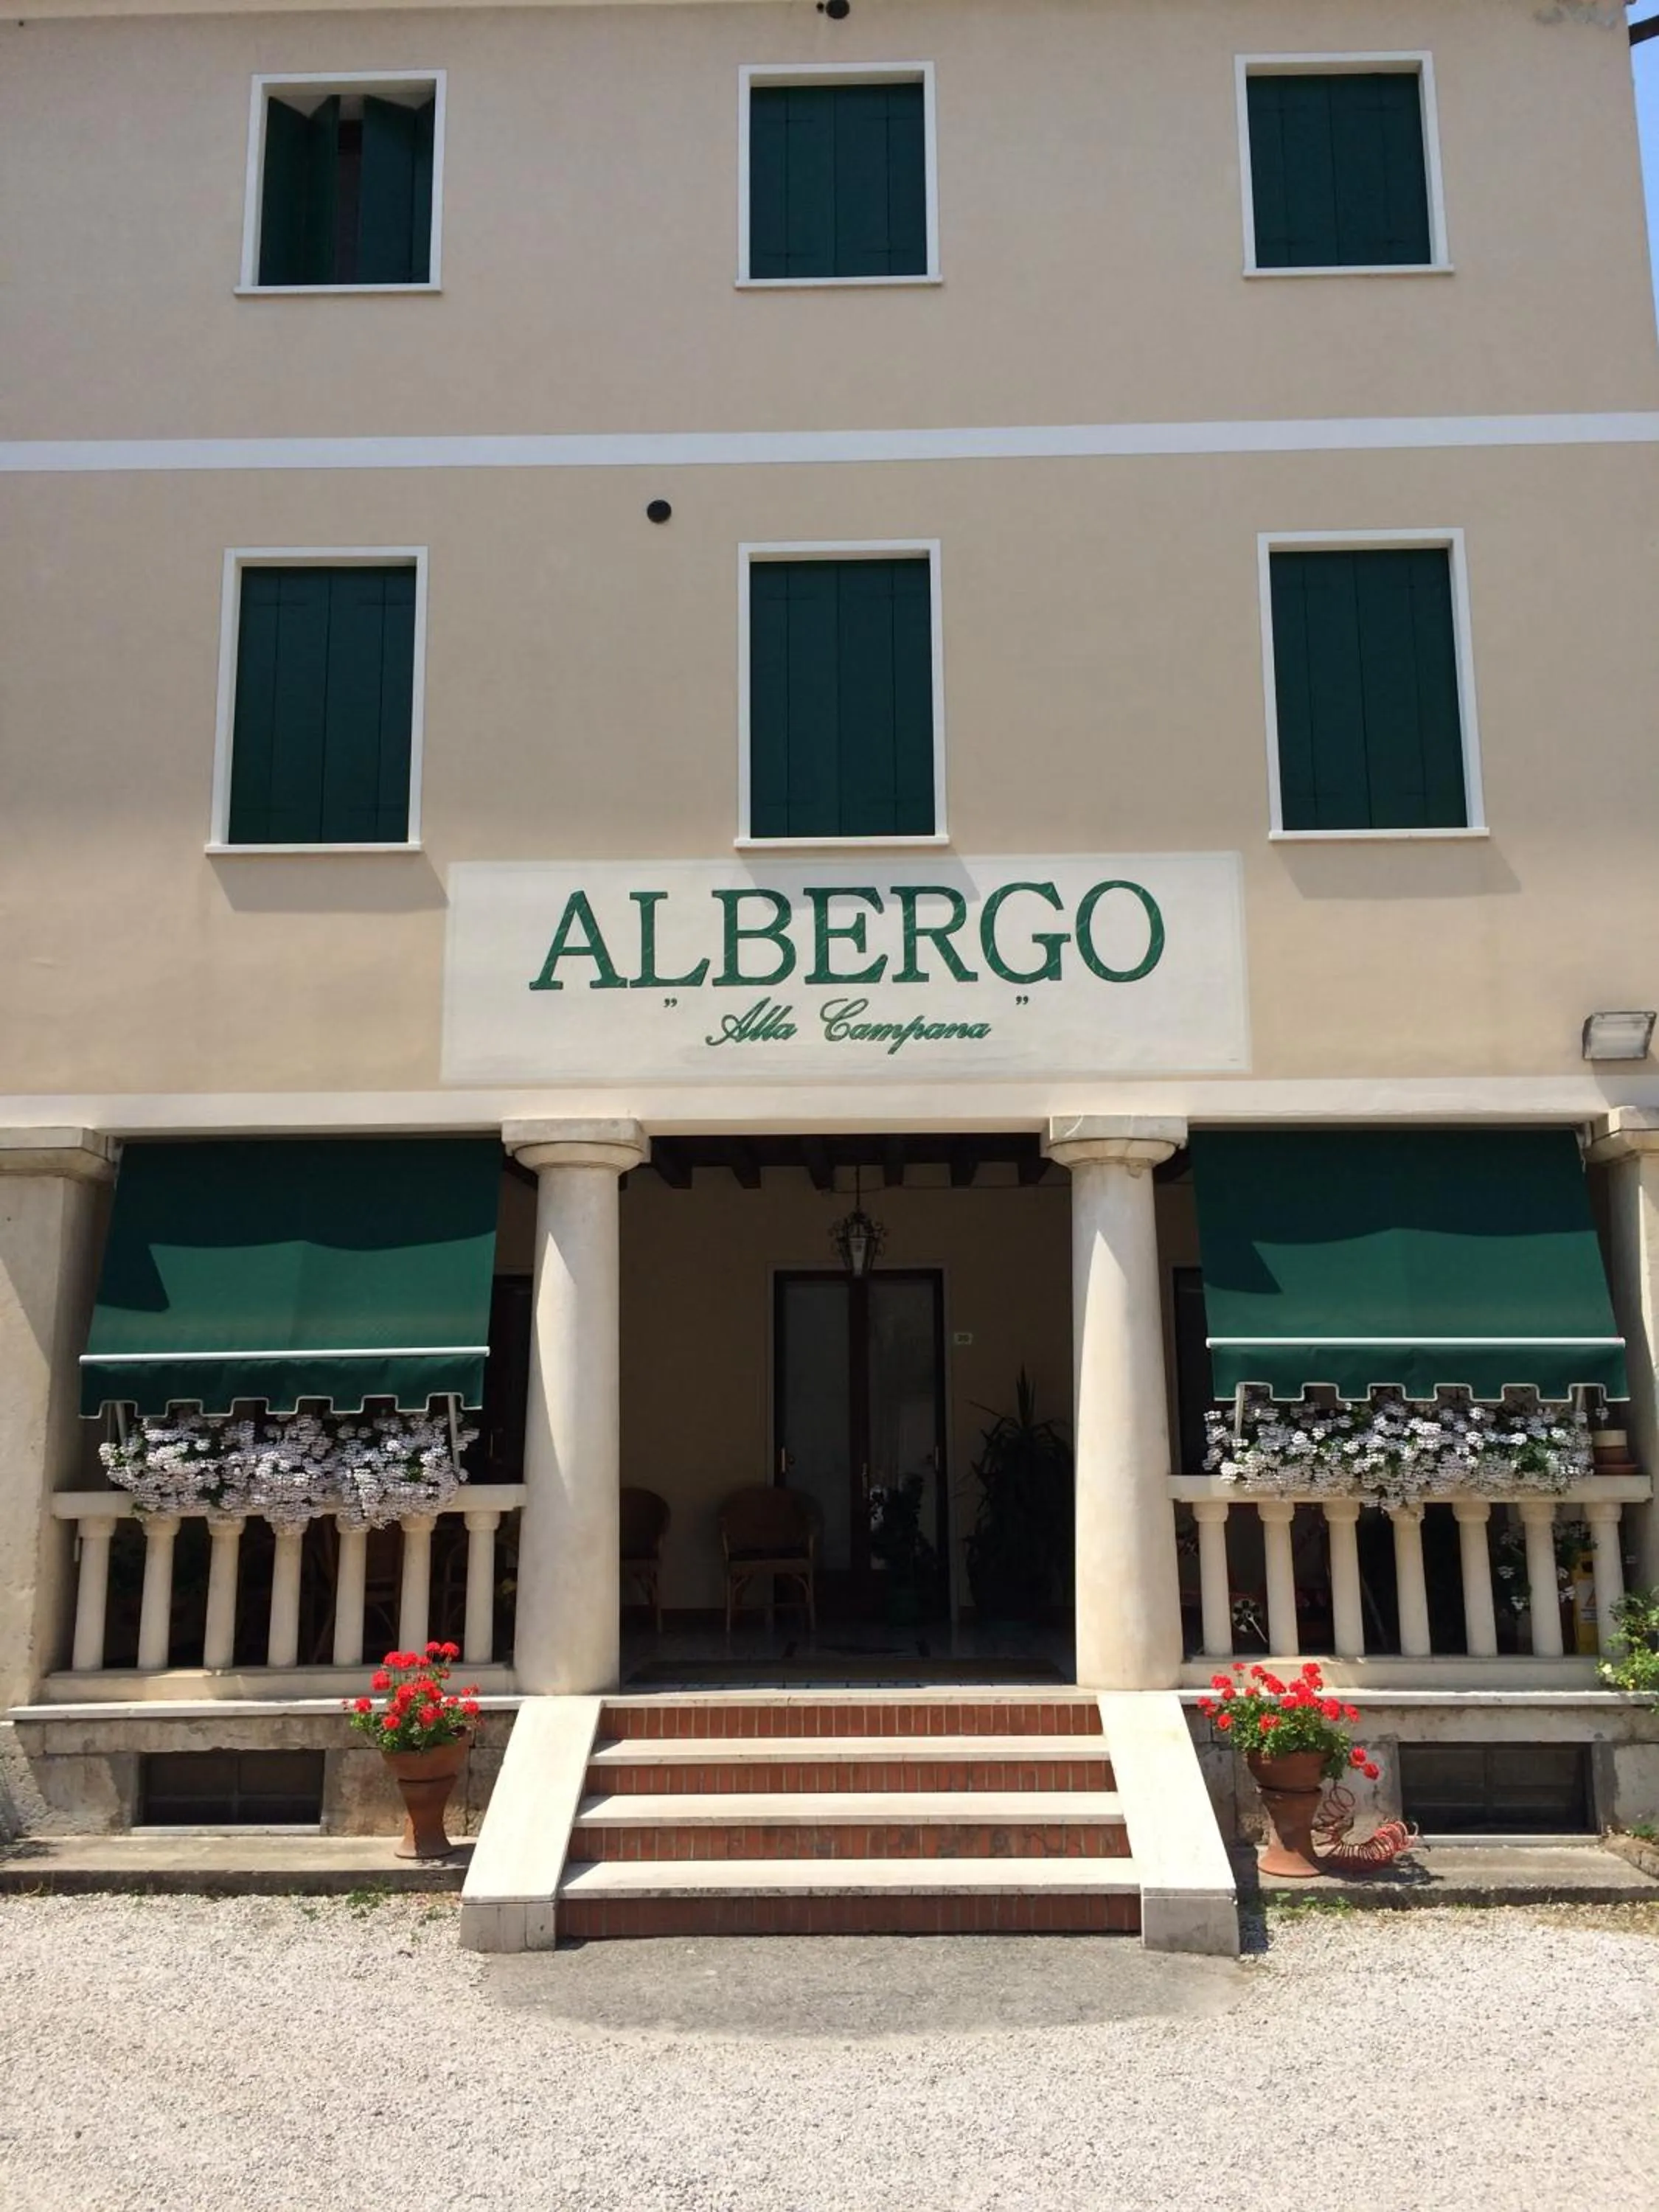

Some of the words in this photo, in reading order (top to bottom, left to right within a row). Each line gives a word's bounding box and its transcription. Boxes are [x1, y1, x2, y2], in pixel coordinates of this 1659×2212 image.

[529, 880, 1166, 990] ALBERGO
[705, 997, 797, 1046] Alla
[820, 998, 992, 1054] Campana
